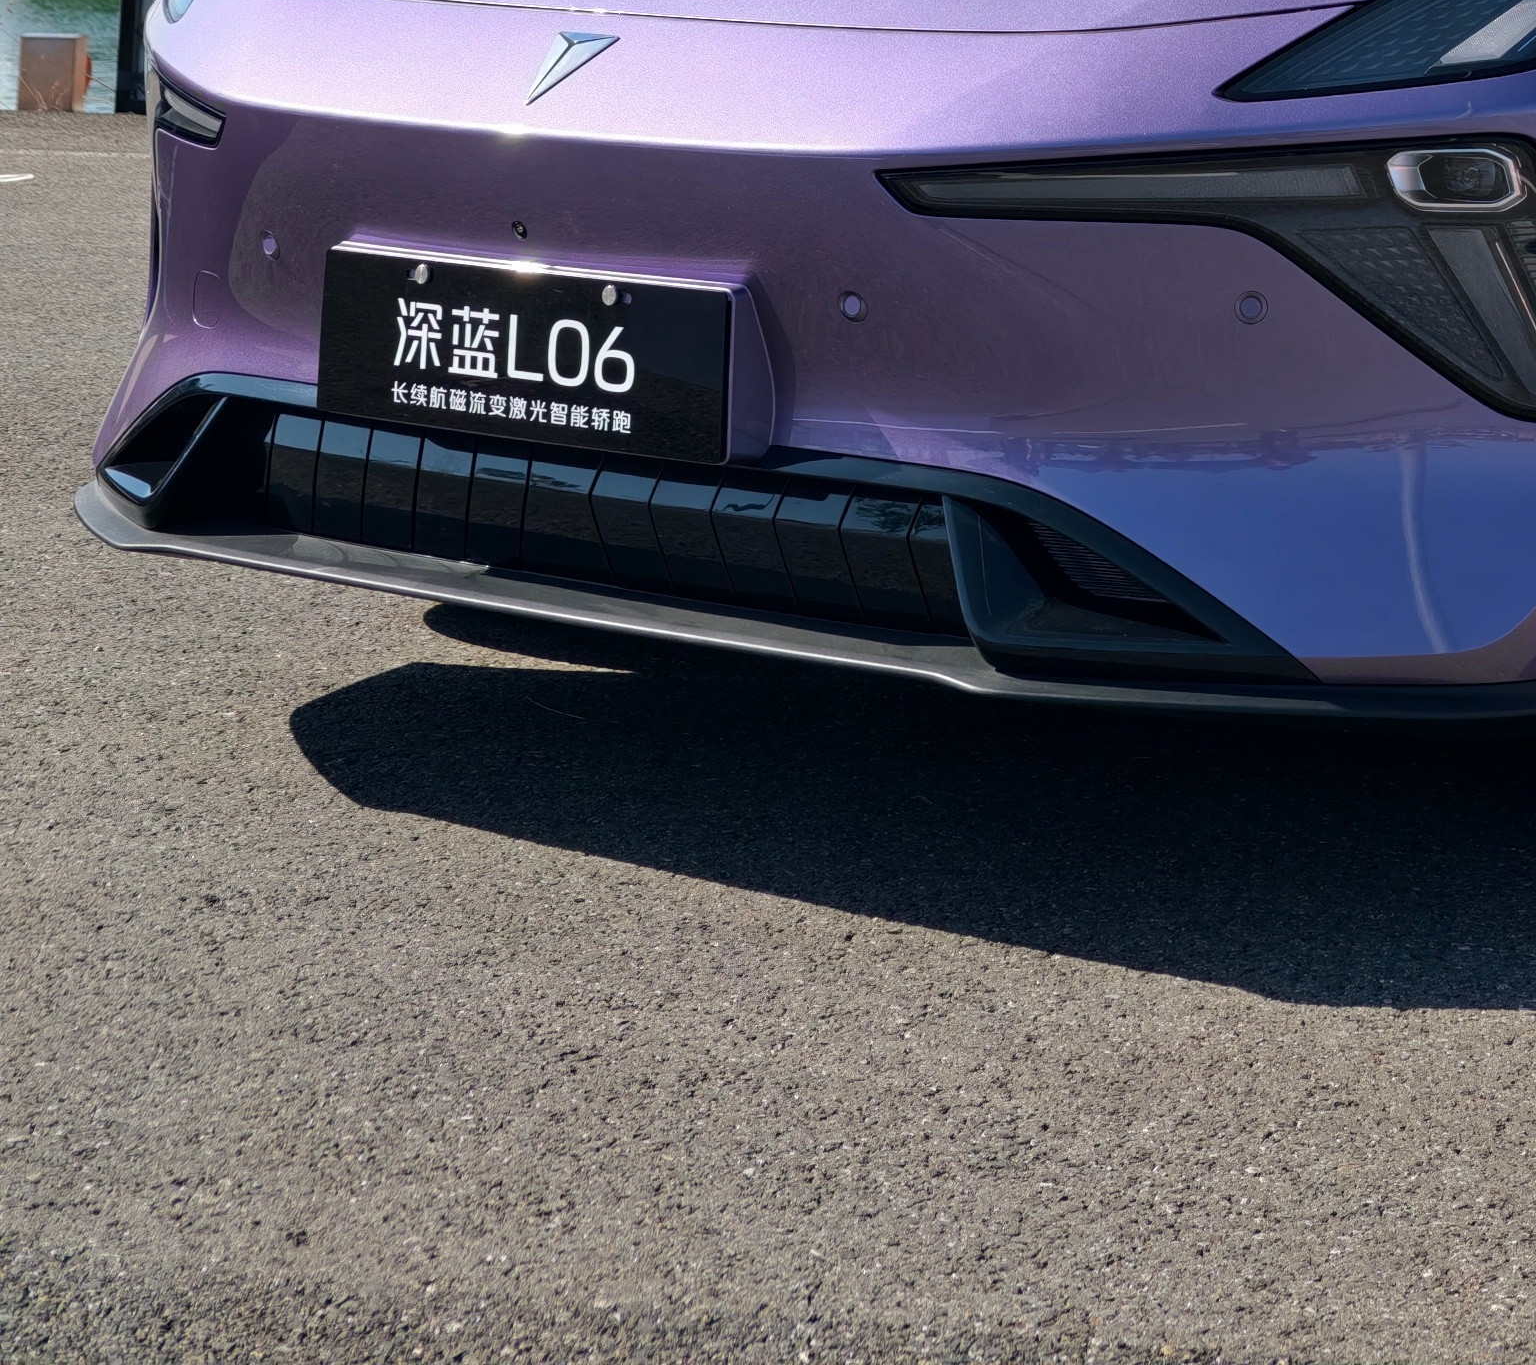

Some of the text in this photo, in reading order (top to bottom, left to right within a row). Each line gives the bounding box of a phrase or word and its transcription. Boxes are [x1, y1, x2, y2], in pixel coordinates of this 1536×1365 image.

[394, 297, 635, 393] 深蓝L06
[390, 380, 632, 434] 长续航磁流变激光智能轿跑
